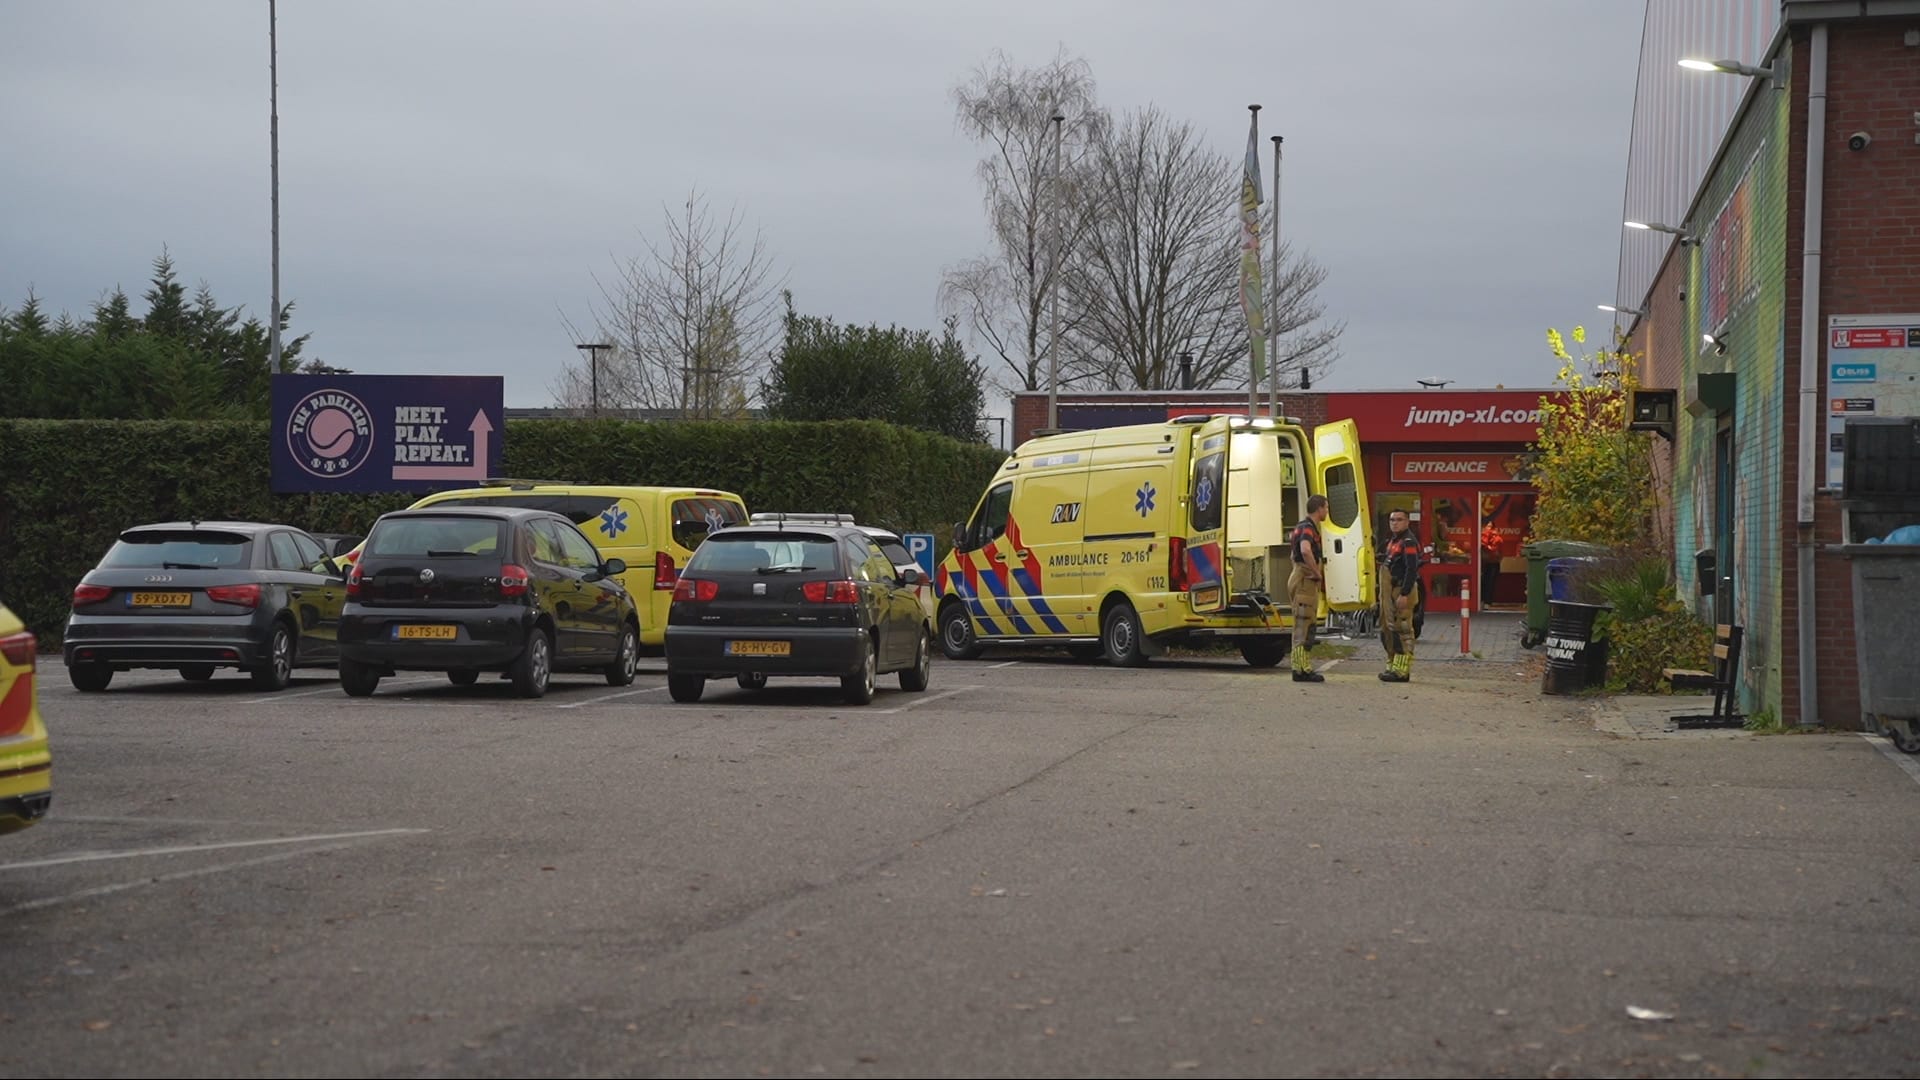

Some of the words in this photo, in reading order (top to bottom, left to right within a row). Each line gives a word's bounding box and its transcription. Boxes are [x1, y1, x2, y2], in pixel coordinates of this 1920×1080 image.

[292, 406, 311, 435] THE
[310, 394, 369, 436] PADELLERS
[394, 406, 448, 424] MEET.
[1404, 405, 1549, 427] jump-xl.com
[394, 425, 444, 443] PLAY.
[394, 445, 470, 463] REPEAT.
[1404, 461, 1489, 473] ENTRANCE
[1052, 503, 1081, 522] RAV
[910, 537, 928, 560] P
[1048, 552, 1109, 567] AMBULANCE
[1120, 550, 1150, 563] 20-161
[1151, 576, 1166, 589] 112
[402, 626, 450, 637] 16-TS-LH
[733, 641, 788, 653] 36-HV-GV
[1559, 639, 1586, 650] TOWN
